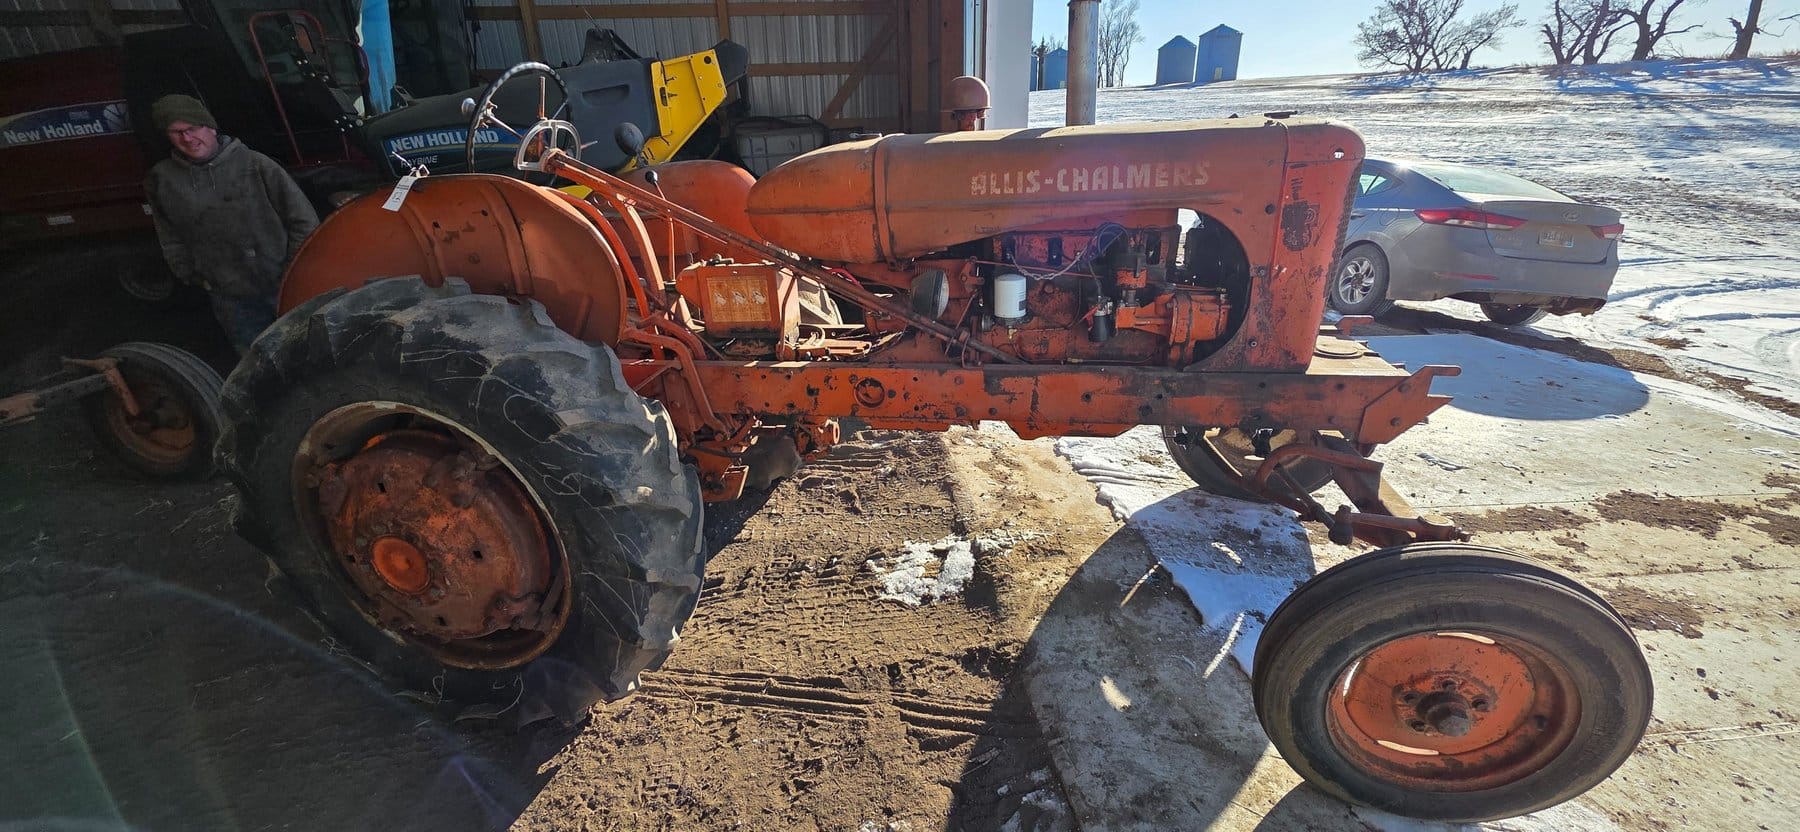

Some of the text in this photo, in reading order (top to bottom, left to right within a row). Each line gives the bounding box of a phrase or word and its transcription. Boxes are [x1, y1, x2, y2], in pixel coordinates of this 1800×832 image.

[3, 119, 104, 144] New Holland
[390, 135, 425, 152] NEW
[971, 161, 1210, 196] ALLIS-CHALMERS
